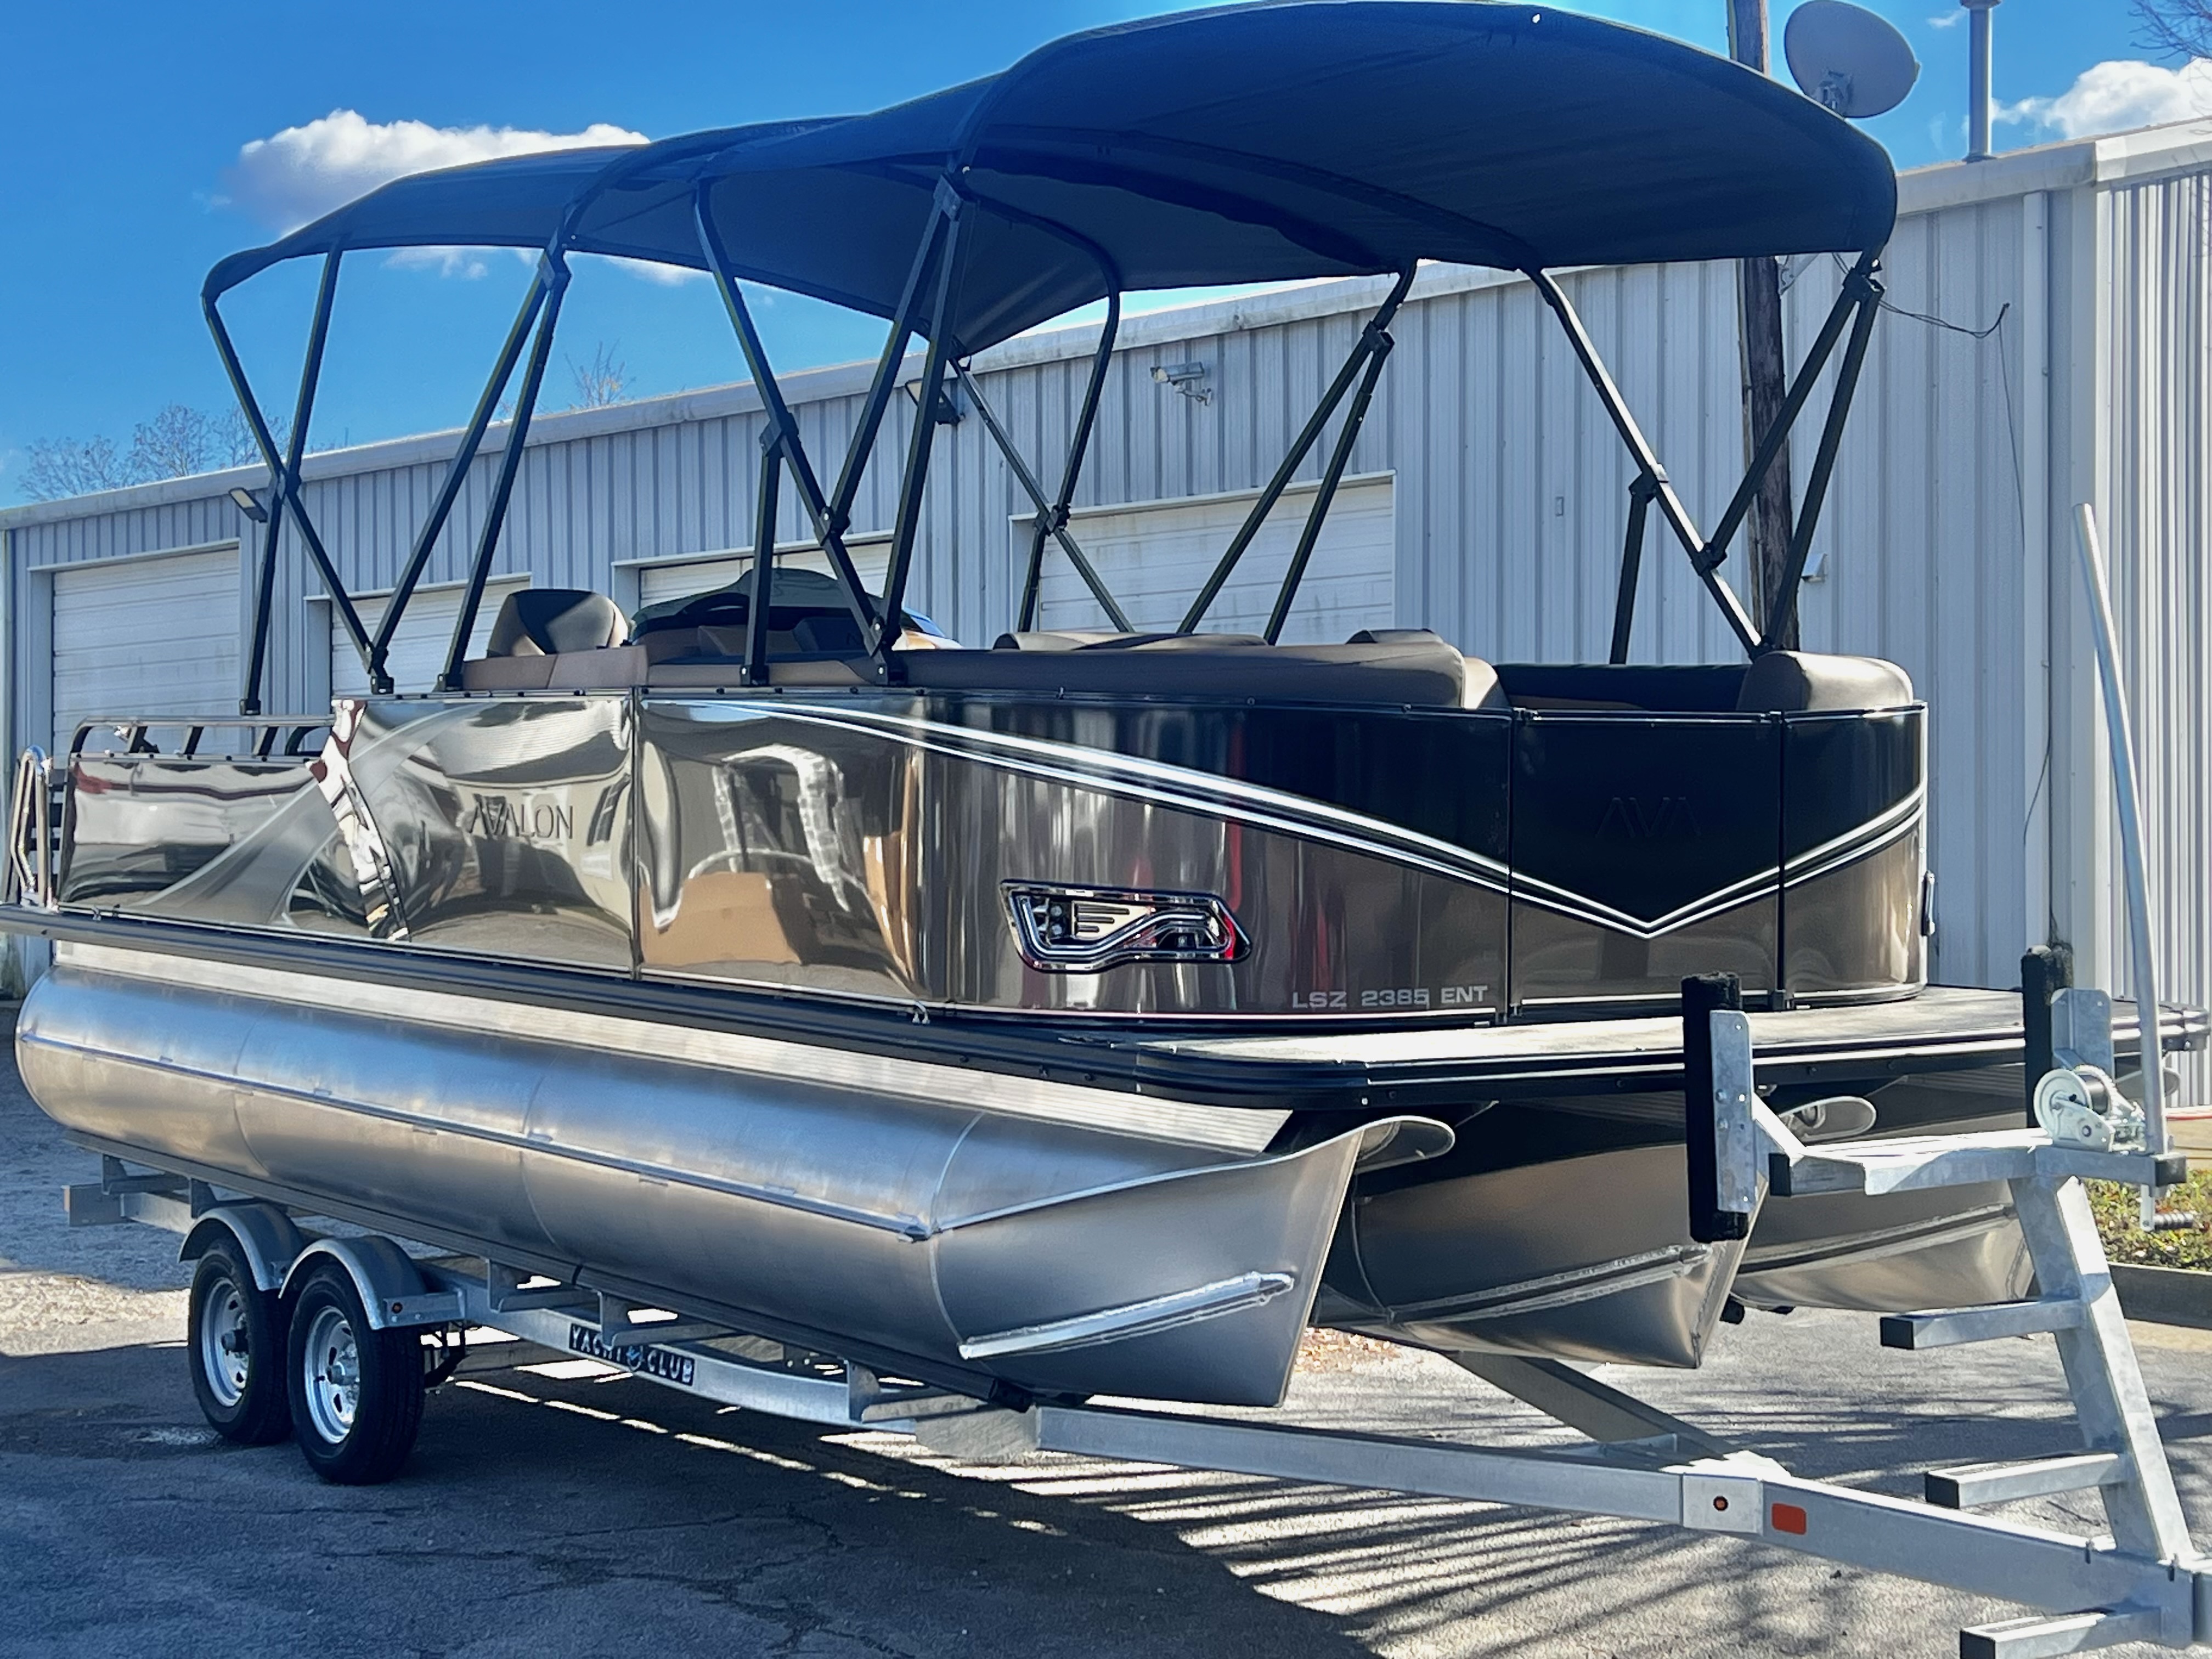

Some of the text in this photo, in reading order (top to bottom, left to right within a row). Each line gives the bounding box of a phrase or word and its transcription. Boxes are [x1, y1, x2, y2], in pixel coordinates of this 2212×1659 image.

[469, 800, 573, 839] AVALON
[1293, 985, 1488, 1008] LSZ 2385 ENT
[647, 1349, 692, 1383] CLUB
